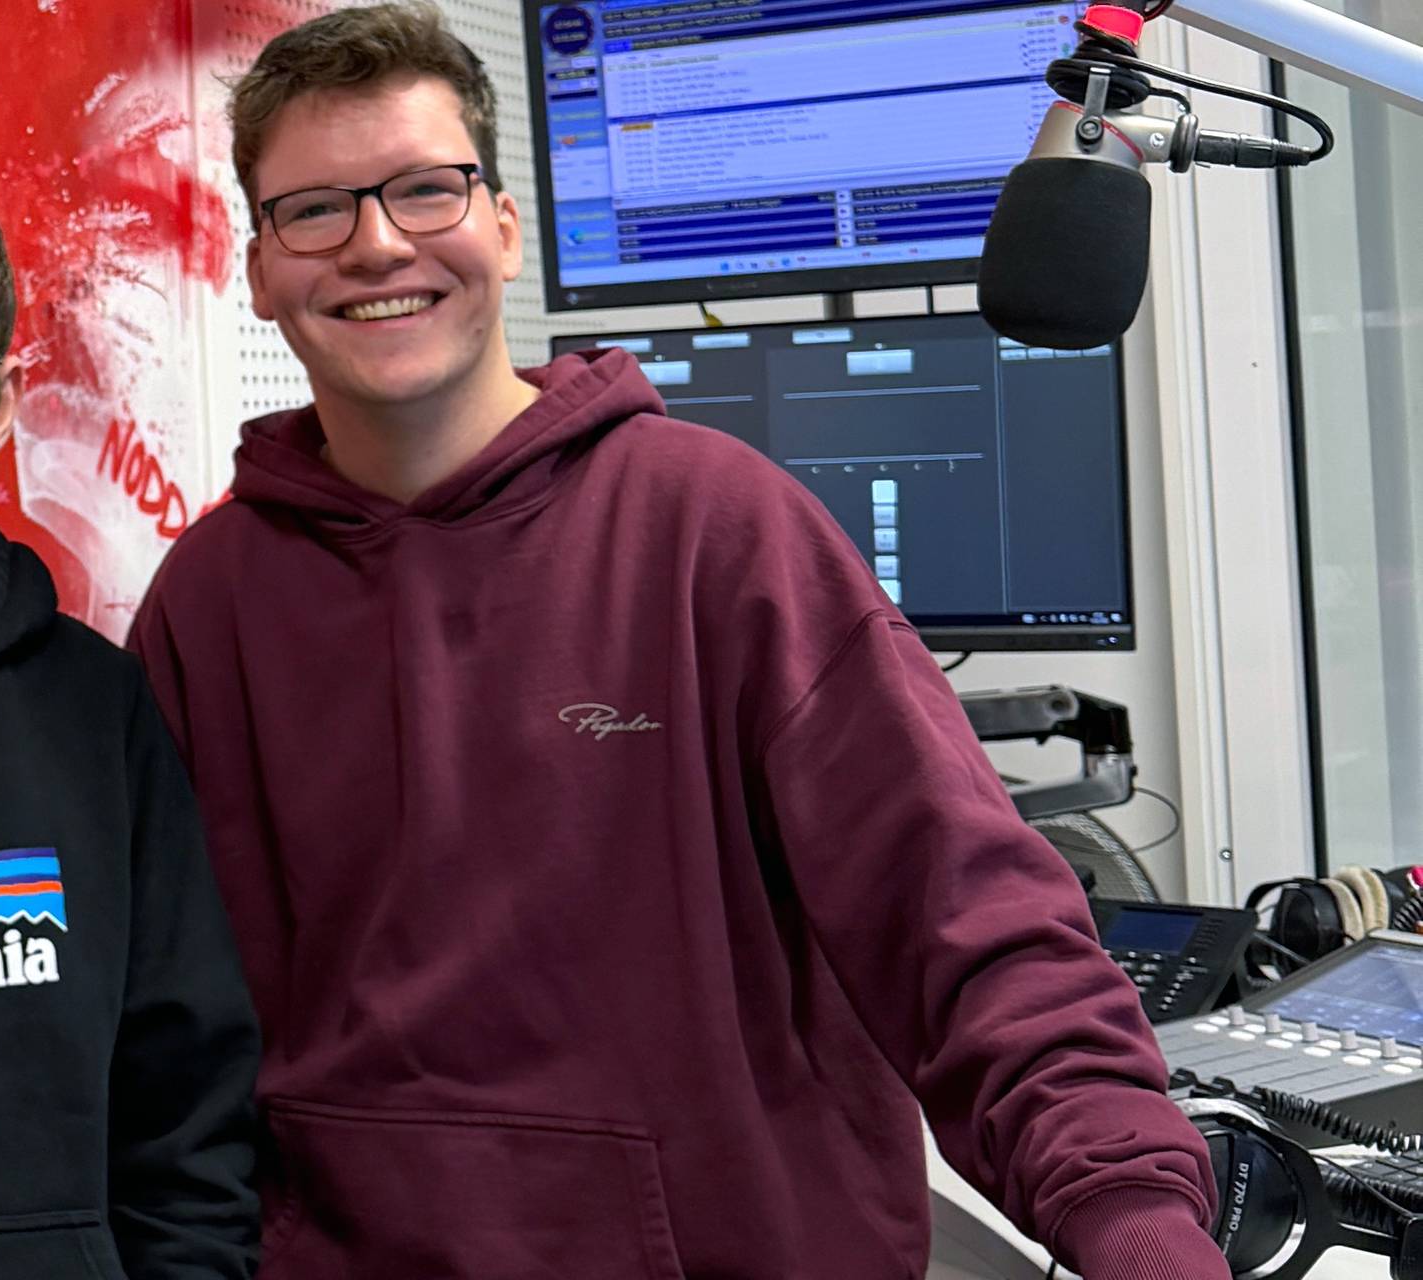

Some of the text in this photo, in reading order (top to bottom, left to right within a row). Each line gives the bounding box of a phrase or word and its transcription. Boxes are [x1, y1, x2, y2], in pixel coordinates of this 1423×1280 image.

[1238, 1162, 1250, 1180] DT
[1233, 1181, 1248, 1205] 770
[1228, 1206, 1243, 1232] PRO
